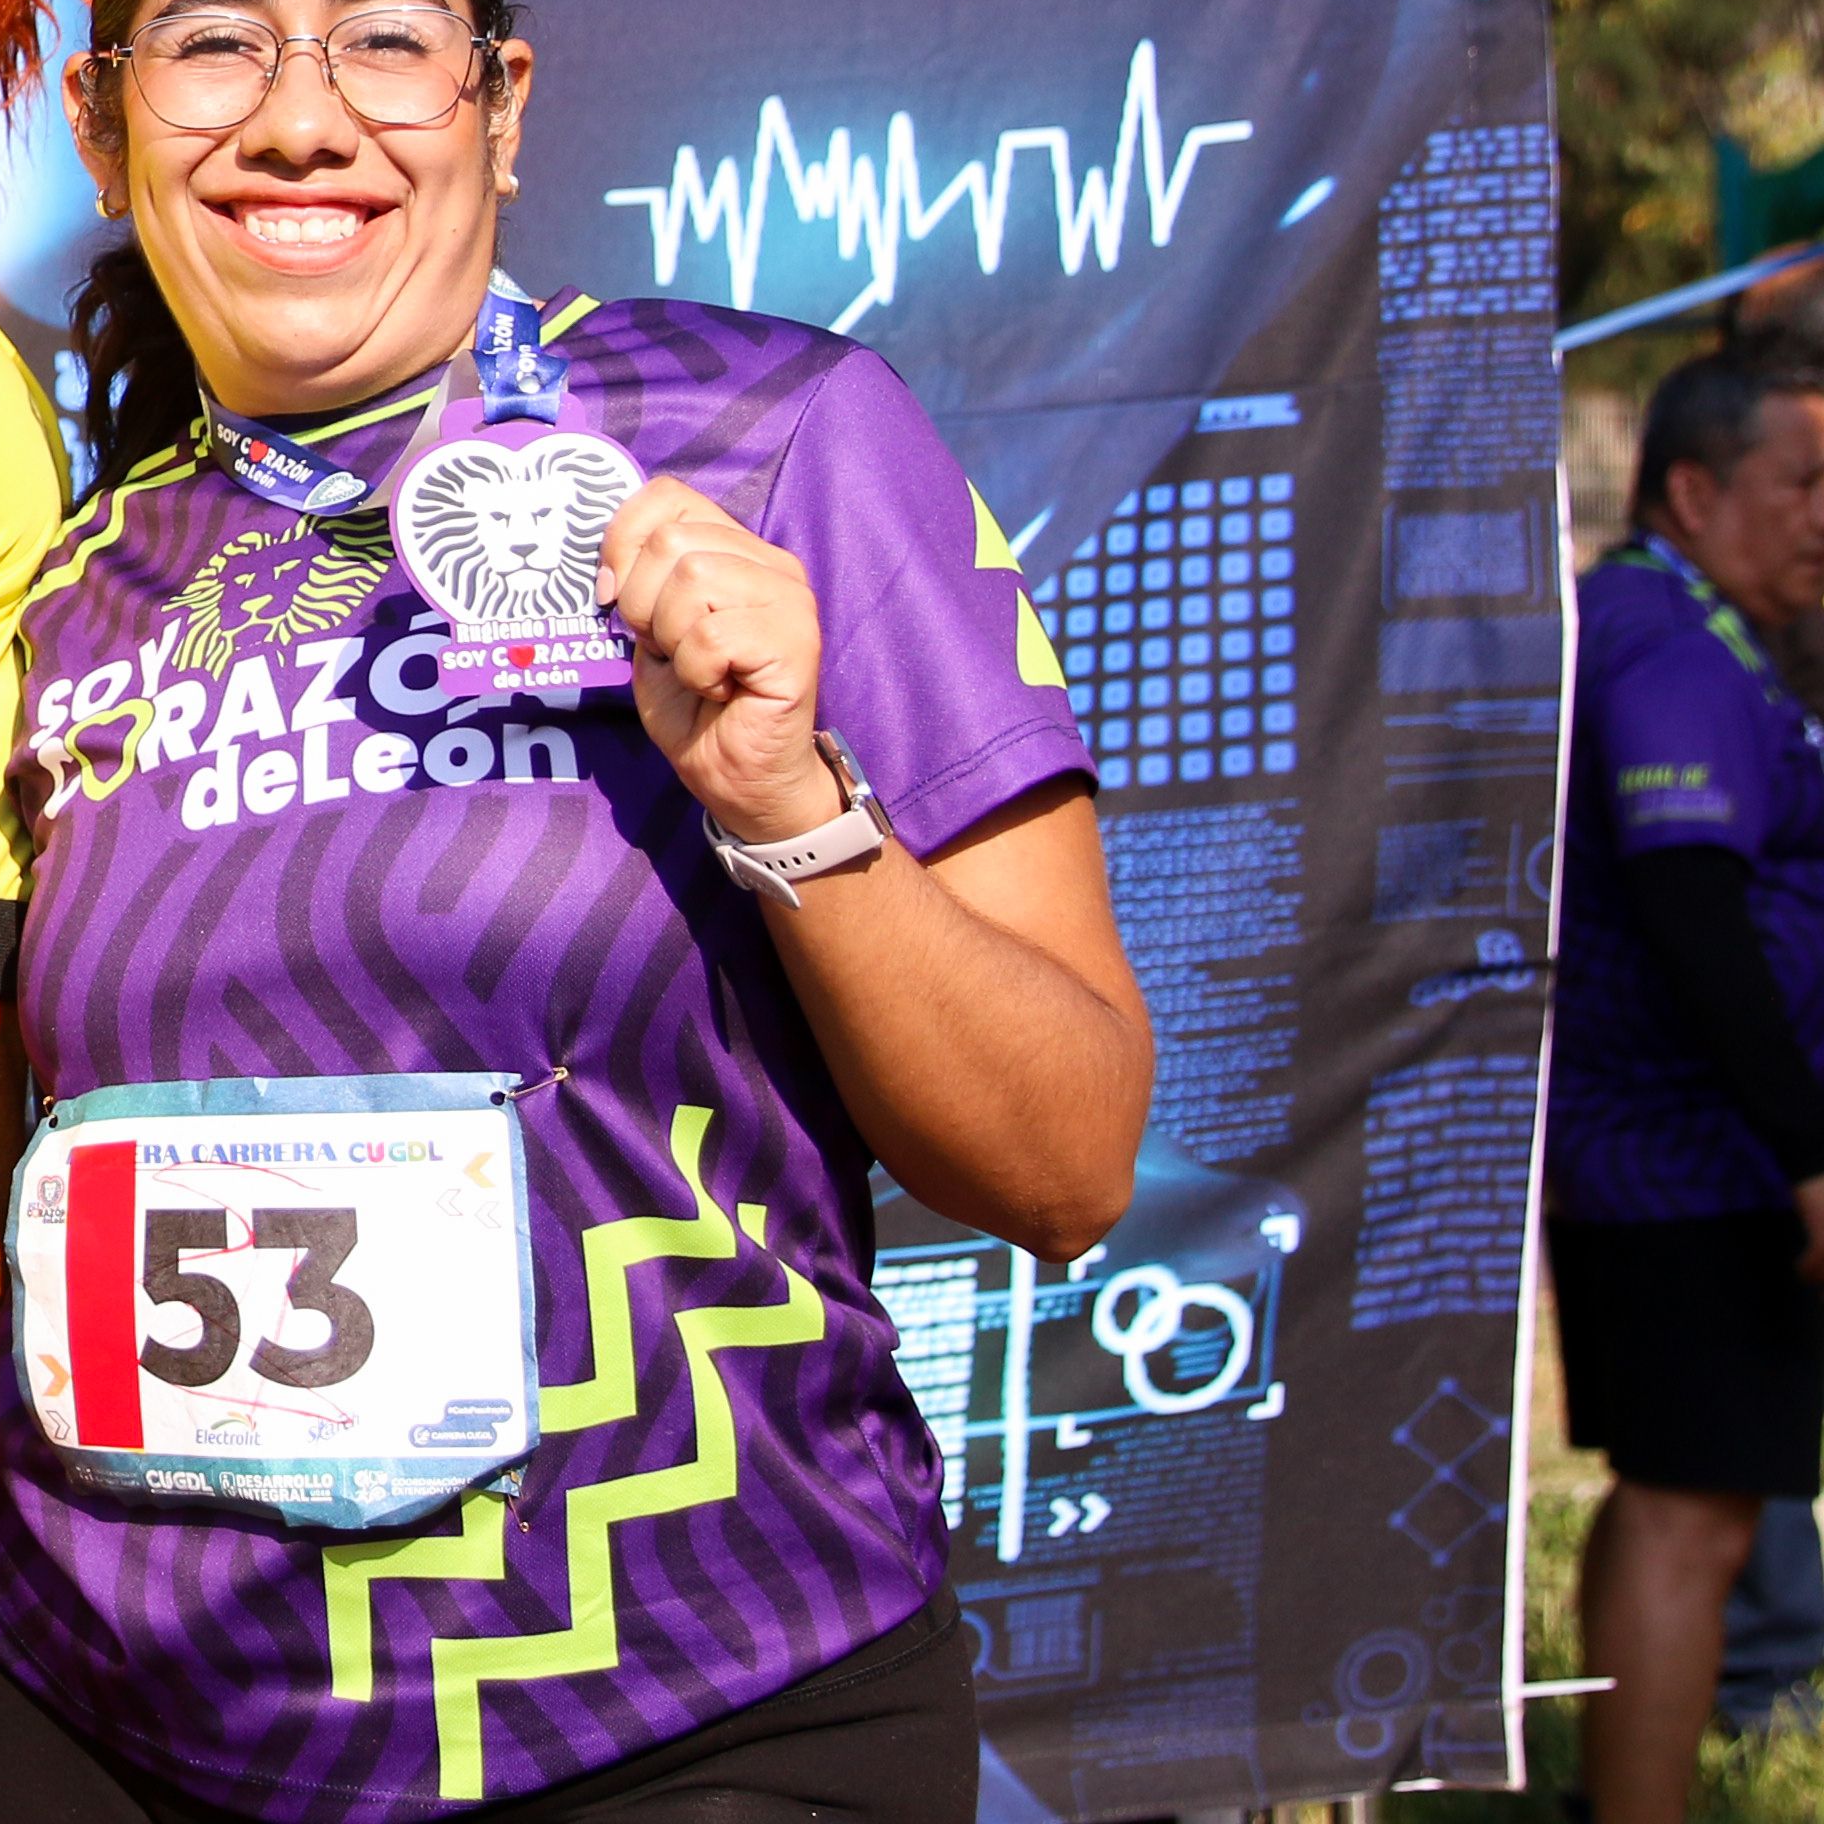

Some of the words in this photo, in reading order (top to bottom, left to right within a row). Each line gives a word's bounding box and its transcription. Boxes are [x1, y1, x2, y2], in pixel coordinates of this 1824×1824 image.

[216, 423, 241, 448] SOY
[442, 650, 488, 670] SOY
[29, 617, 182, 749] SOY
[493, 670, 521, 689] de
[524, 664, 580, 687] León
[191, 1141, 337, 1164] CARRERA
[348, 1140, 444, 1164] CUGDL
[138, 1207, 375, 1389] 53
[195, 1428, 262, 1446] Electrolit
[146, 1469, 215, 1493] CUGDL
[236, 1473, 333, 1491] DESARROLLO
[237, 1487, 311, 1503] INTEGRAL
